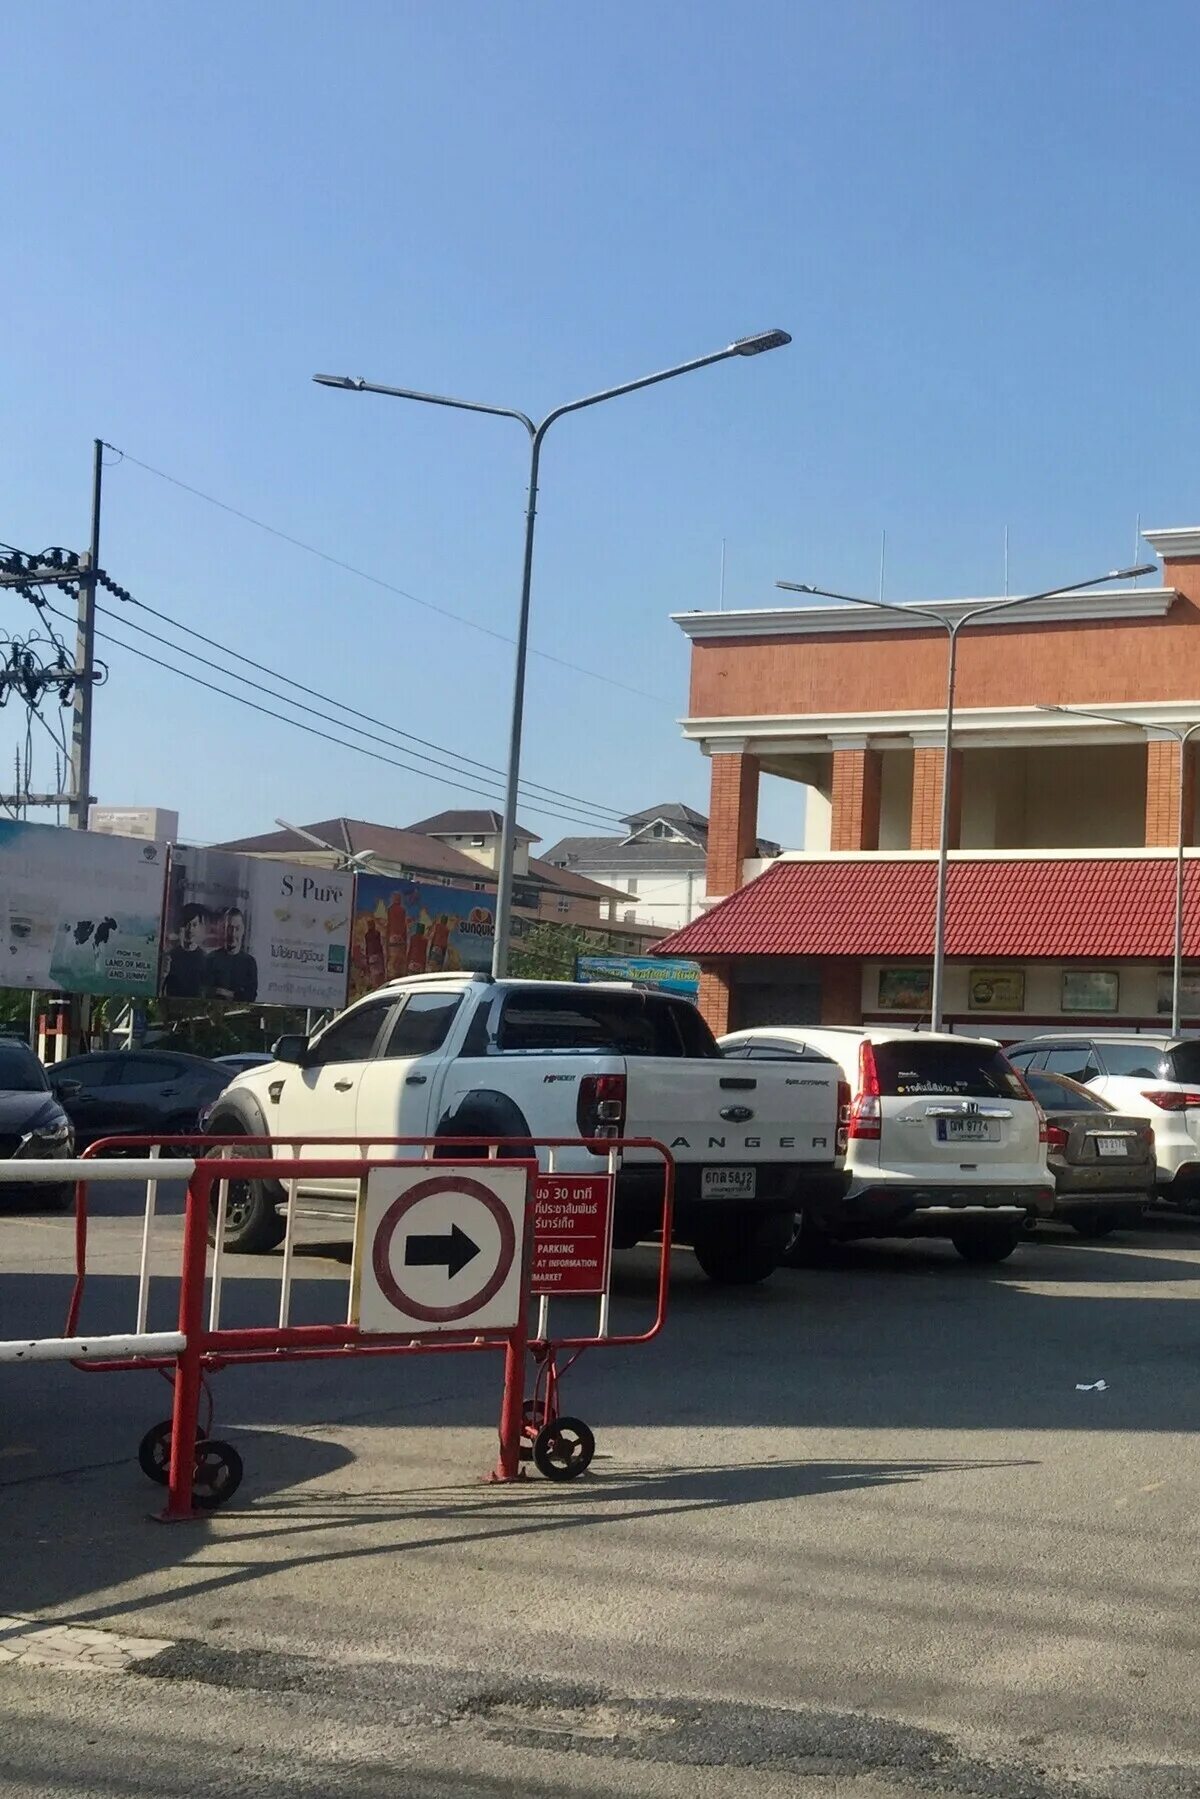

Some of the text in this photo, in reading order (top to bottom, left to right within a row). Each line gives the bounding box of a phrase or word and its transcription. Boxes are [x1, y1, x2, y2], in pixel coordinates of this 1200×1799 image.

[459, 921, 496, 937] SUNQUIC
[967, 1120, 989, 1131] 9774
[669, 1136, 827, 1148] ANGER
[554, 1187, 569, 1199] 30
[537, 1244, 575, 1254] PARKING
[537, 1258, 598, 1268] AT INFORMATION
